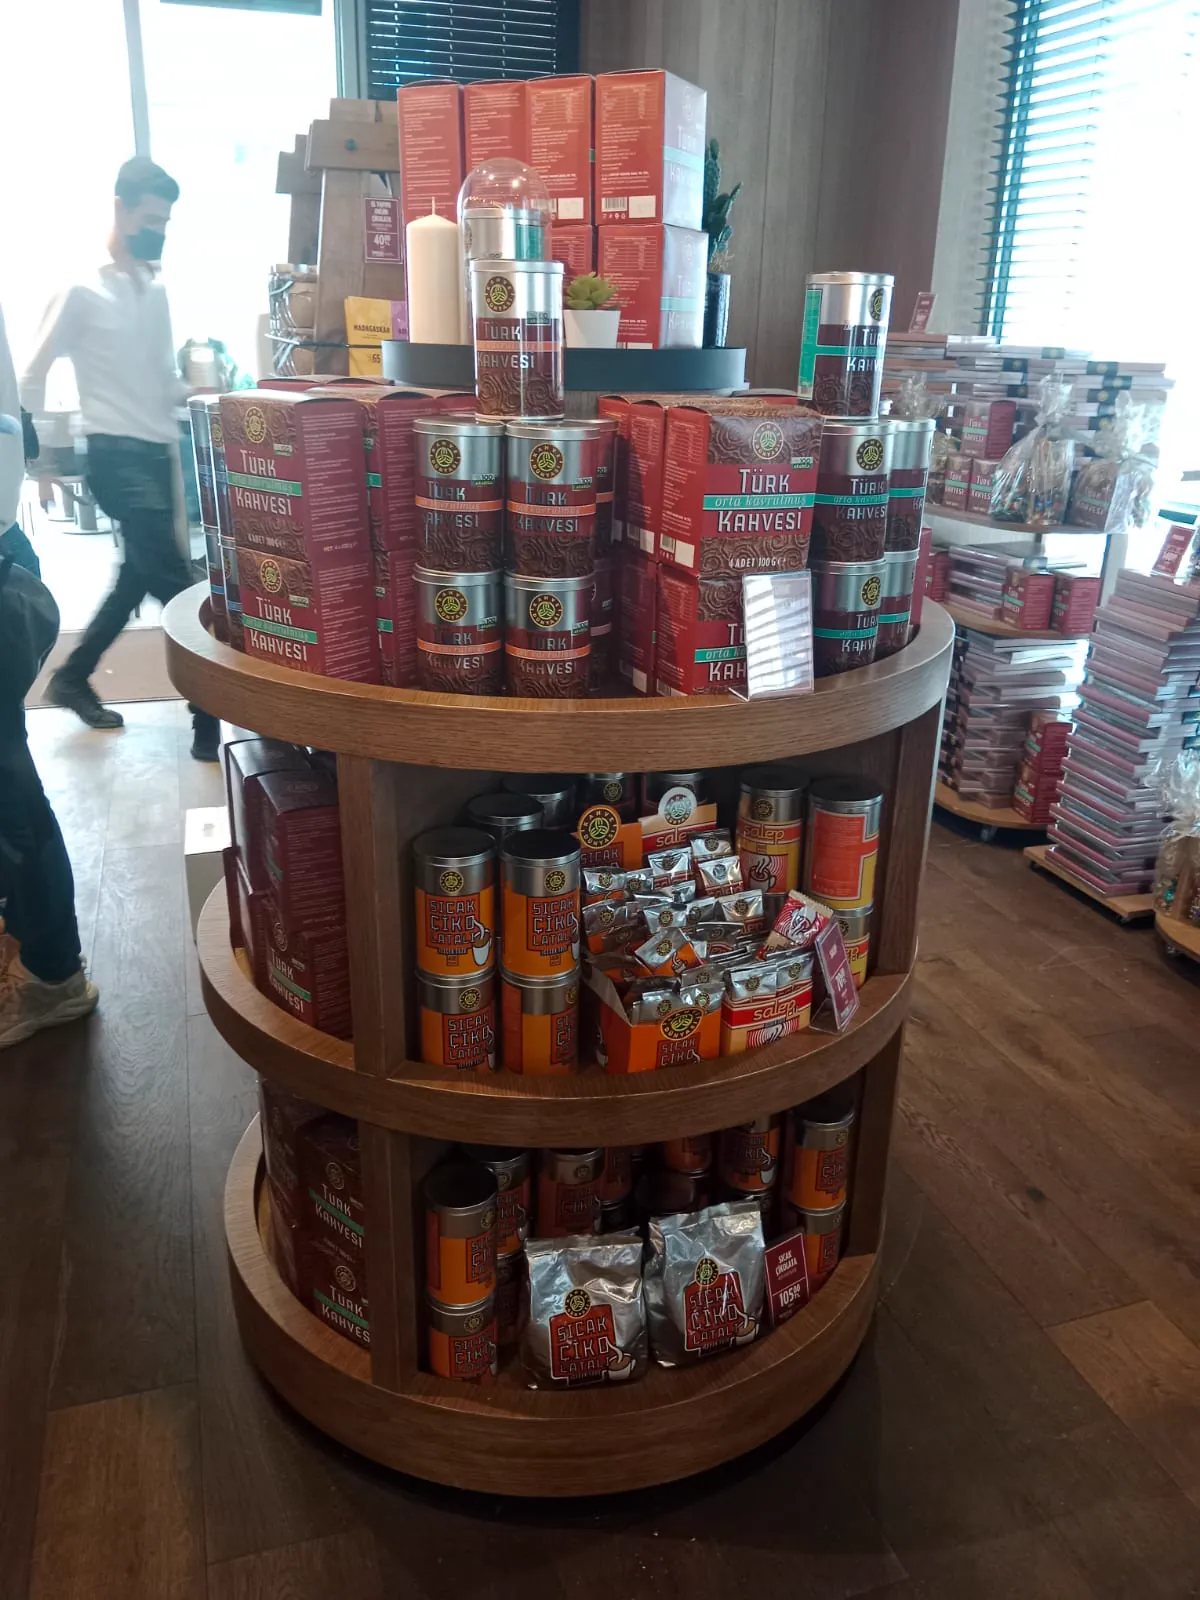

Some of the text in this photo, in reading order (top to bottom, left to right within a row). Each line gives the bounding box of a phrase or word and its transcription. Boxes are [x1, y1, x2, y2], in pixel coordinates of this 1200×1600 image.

[354, 324, 390, 333] MADAGASKAR
[240, 450, 276, 478] TÜRK
[740, 468, 790, 494] TÜRK
[235, 488, 292, 516] KAHVESİ
[715, 494, 806, 507] orta kavrulmuş
[718, 507, 802, 532] KAHVESİ
[735, 556, 755, 568] ADET
[256, 596, 292, 625] TÜRK
[250, 630, 308, 662] KAHVESİ
[582, 810, 616, 828] KAHVE
[656, 827, 688, 847] sale
[744, 824, 784, 844] salep
[430, 900, 475, 913] SICAK
[532, 899, 574, 916] SICAK
[752, 999, 796, 1021] salep
[690, 1285, 736, 1309] SICAK
[322, 1304, 370, 1343] KAHVES
[558, 1317, 607, 1341] SICAK
[560, 1336, 609, 1362] ÇİKO
